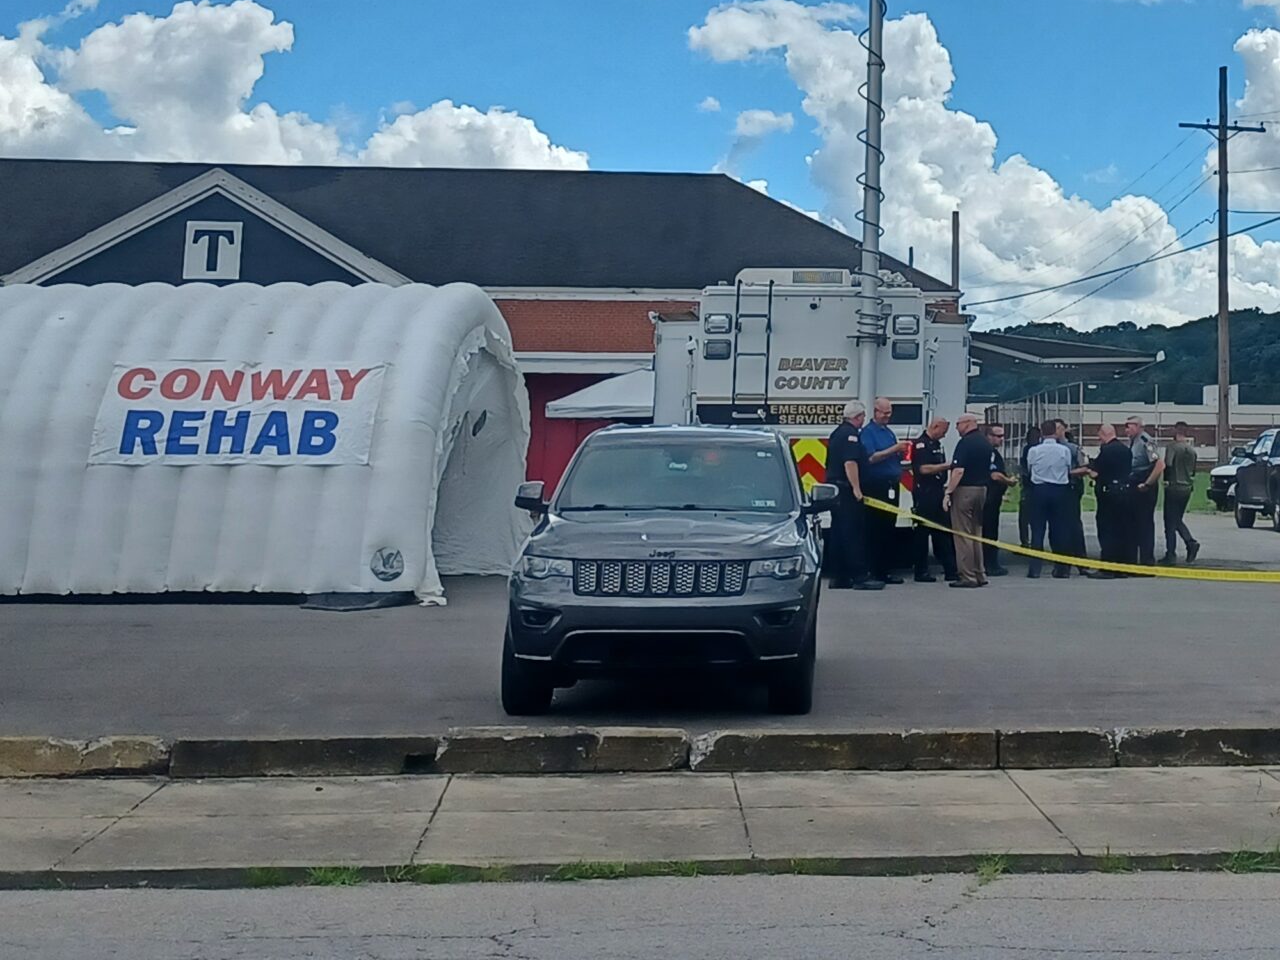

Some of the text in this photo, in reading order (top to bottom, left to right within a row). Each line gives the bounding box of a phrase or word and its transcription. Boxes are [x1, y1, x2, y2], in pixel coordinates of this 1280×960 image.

[192, 230, 235, 272] T
[777, 357, 849, 372] BEAVER
[117, 367, 369, 402] CONWAY
[774, 376, 851, 390] COUNTY
[770, 404, 844, 415] EMERGENC
[778, 414, 844, 425] SERVICES
[119, 409, 340, 456] REHAB
